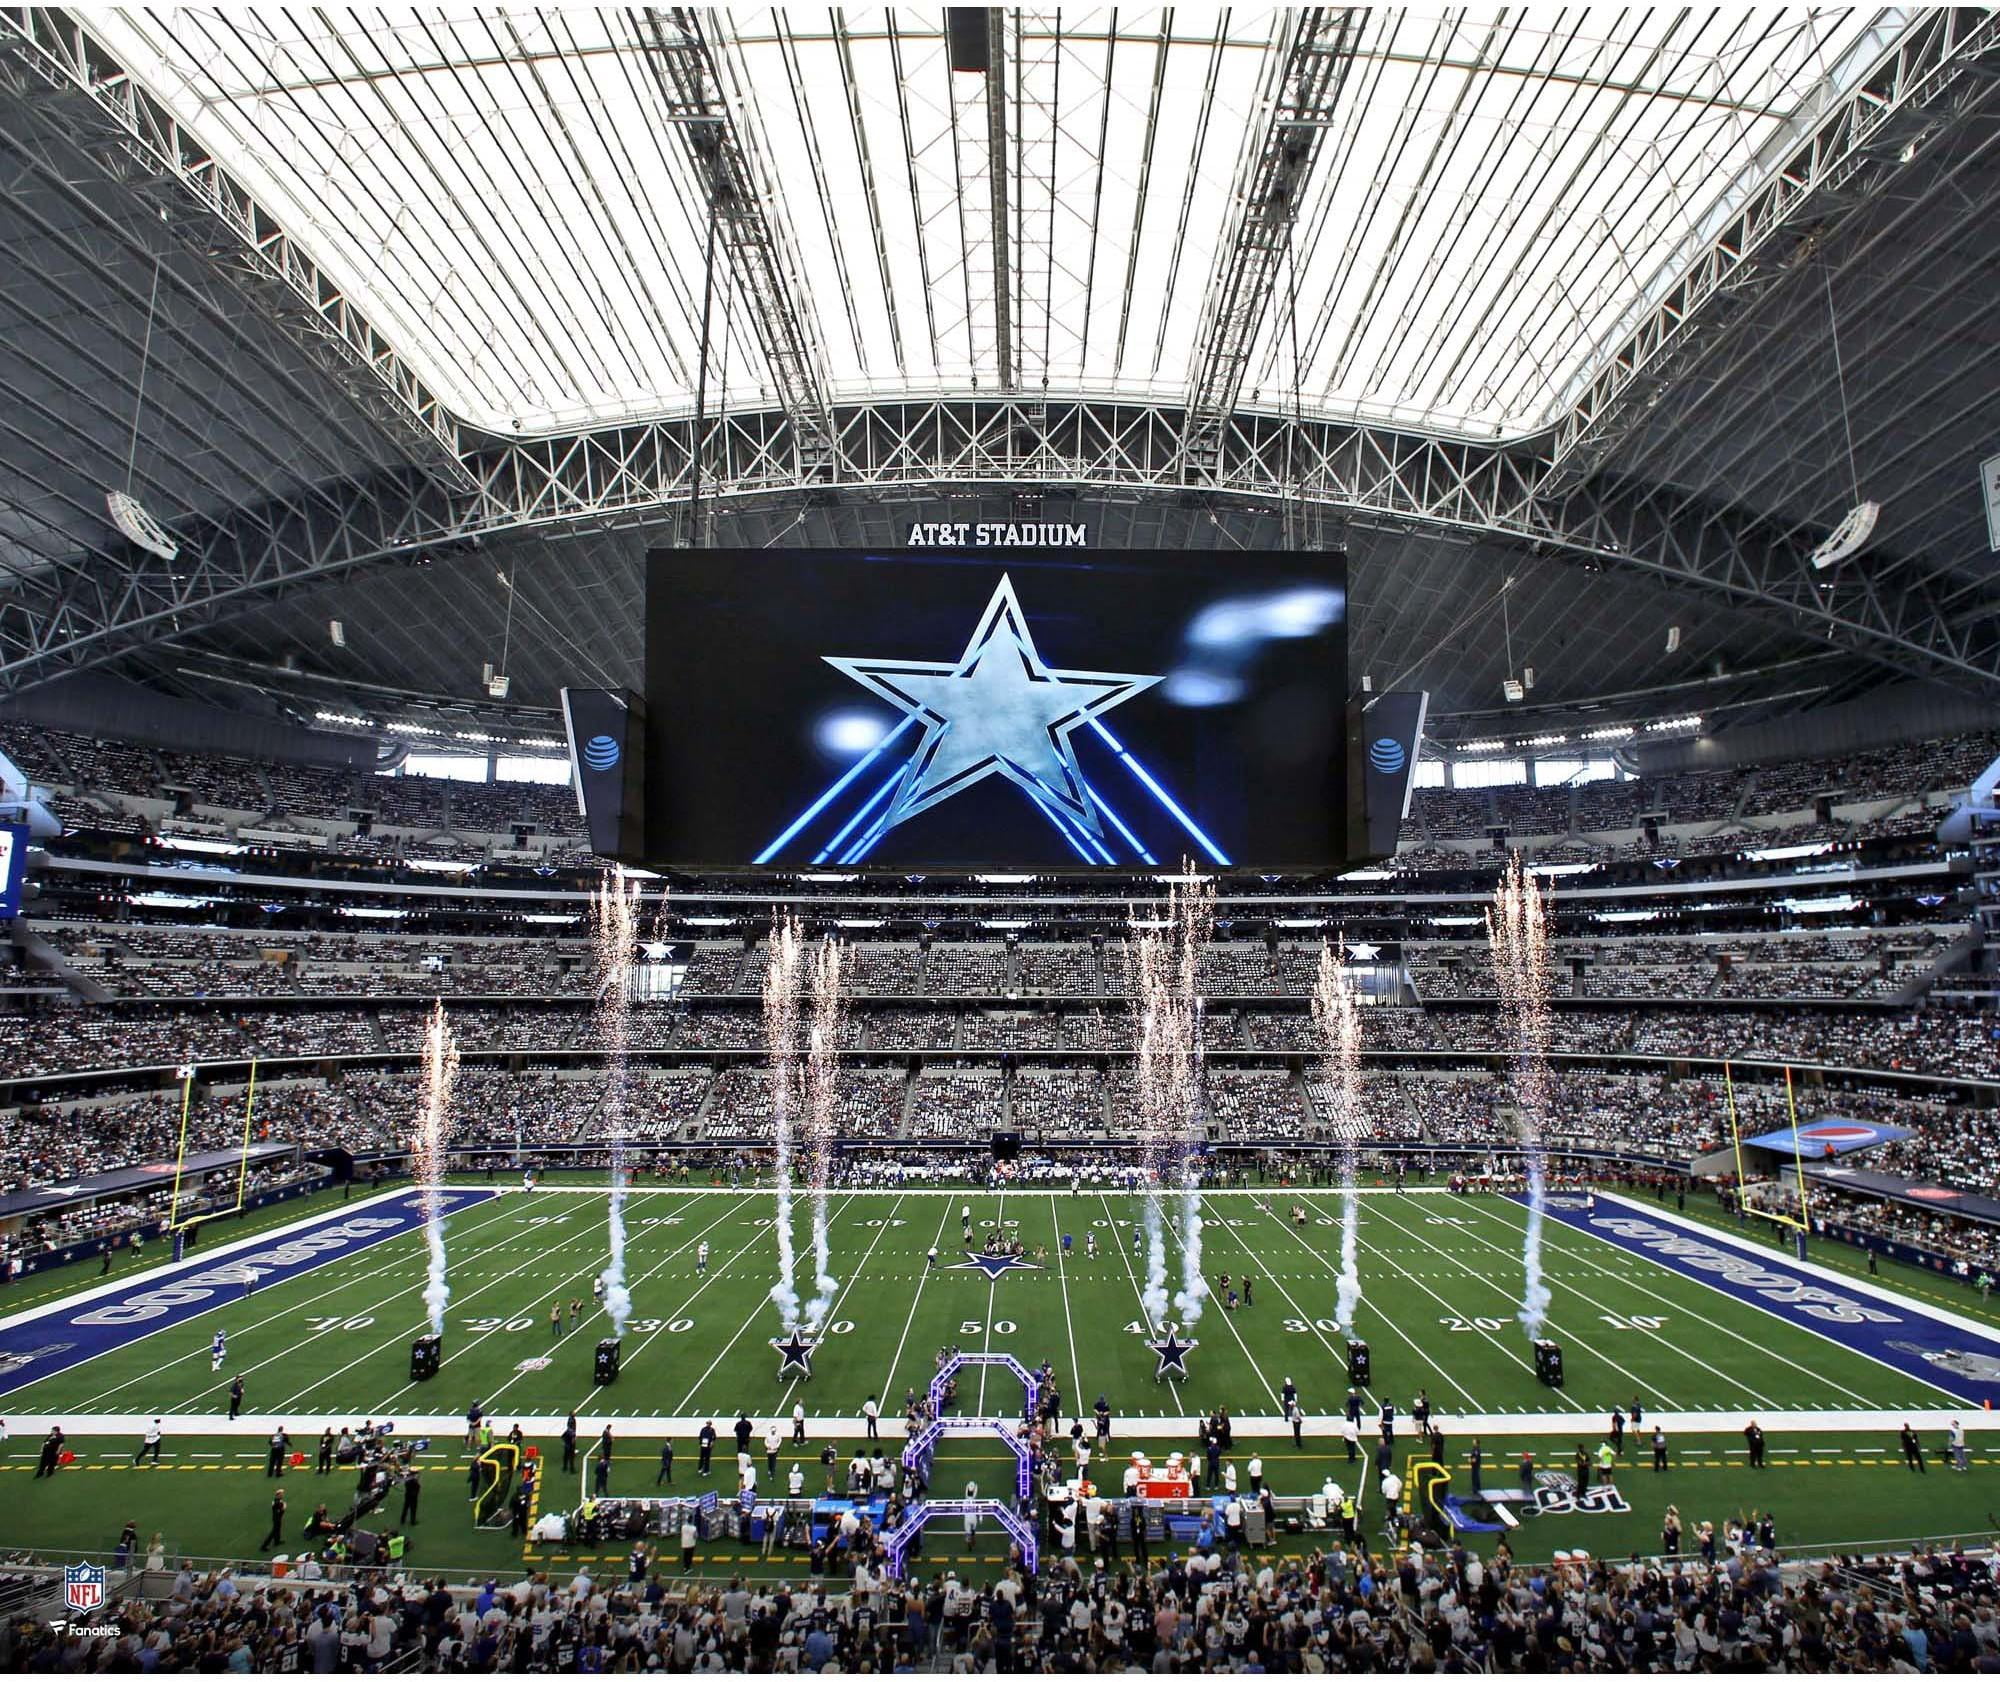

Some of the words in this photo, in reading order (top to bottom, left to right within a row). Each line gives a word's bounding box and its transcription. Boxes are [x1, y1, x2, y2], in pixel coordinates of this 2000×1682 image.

[907, 523, 970, 546] AT&T
[975, 523, 1087, 546] STADIUM
[70, 1217, 405, 1325] COWBOYS
[1589, 1217, 1904, 1324] COWBOYS
[959, 1320, 1018, 1334] 50
